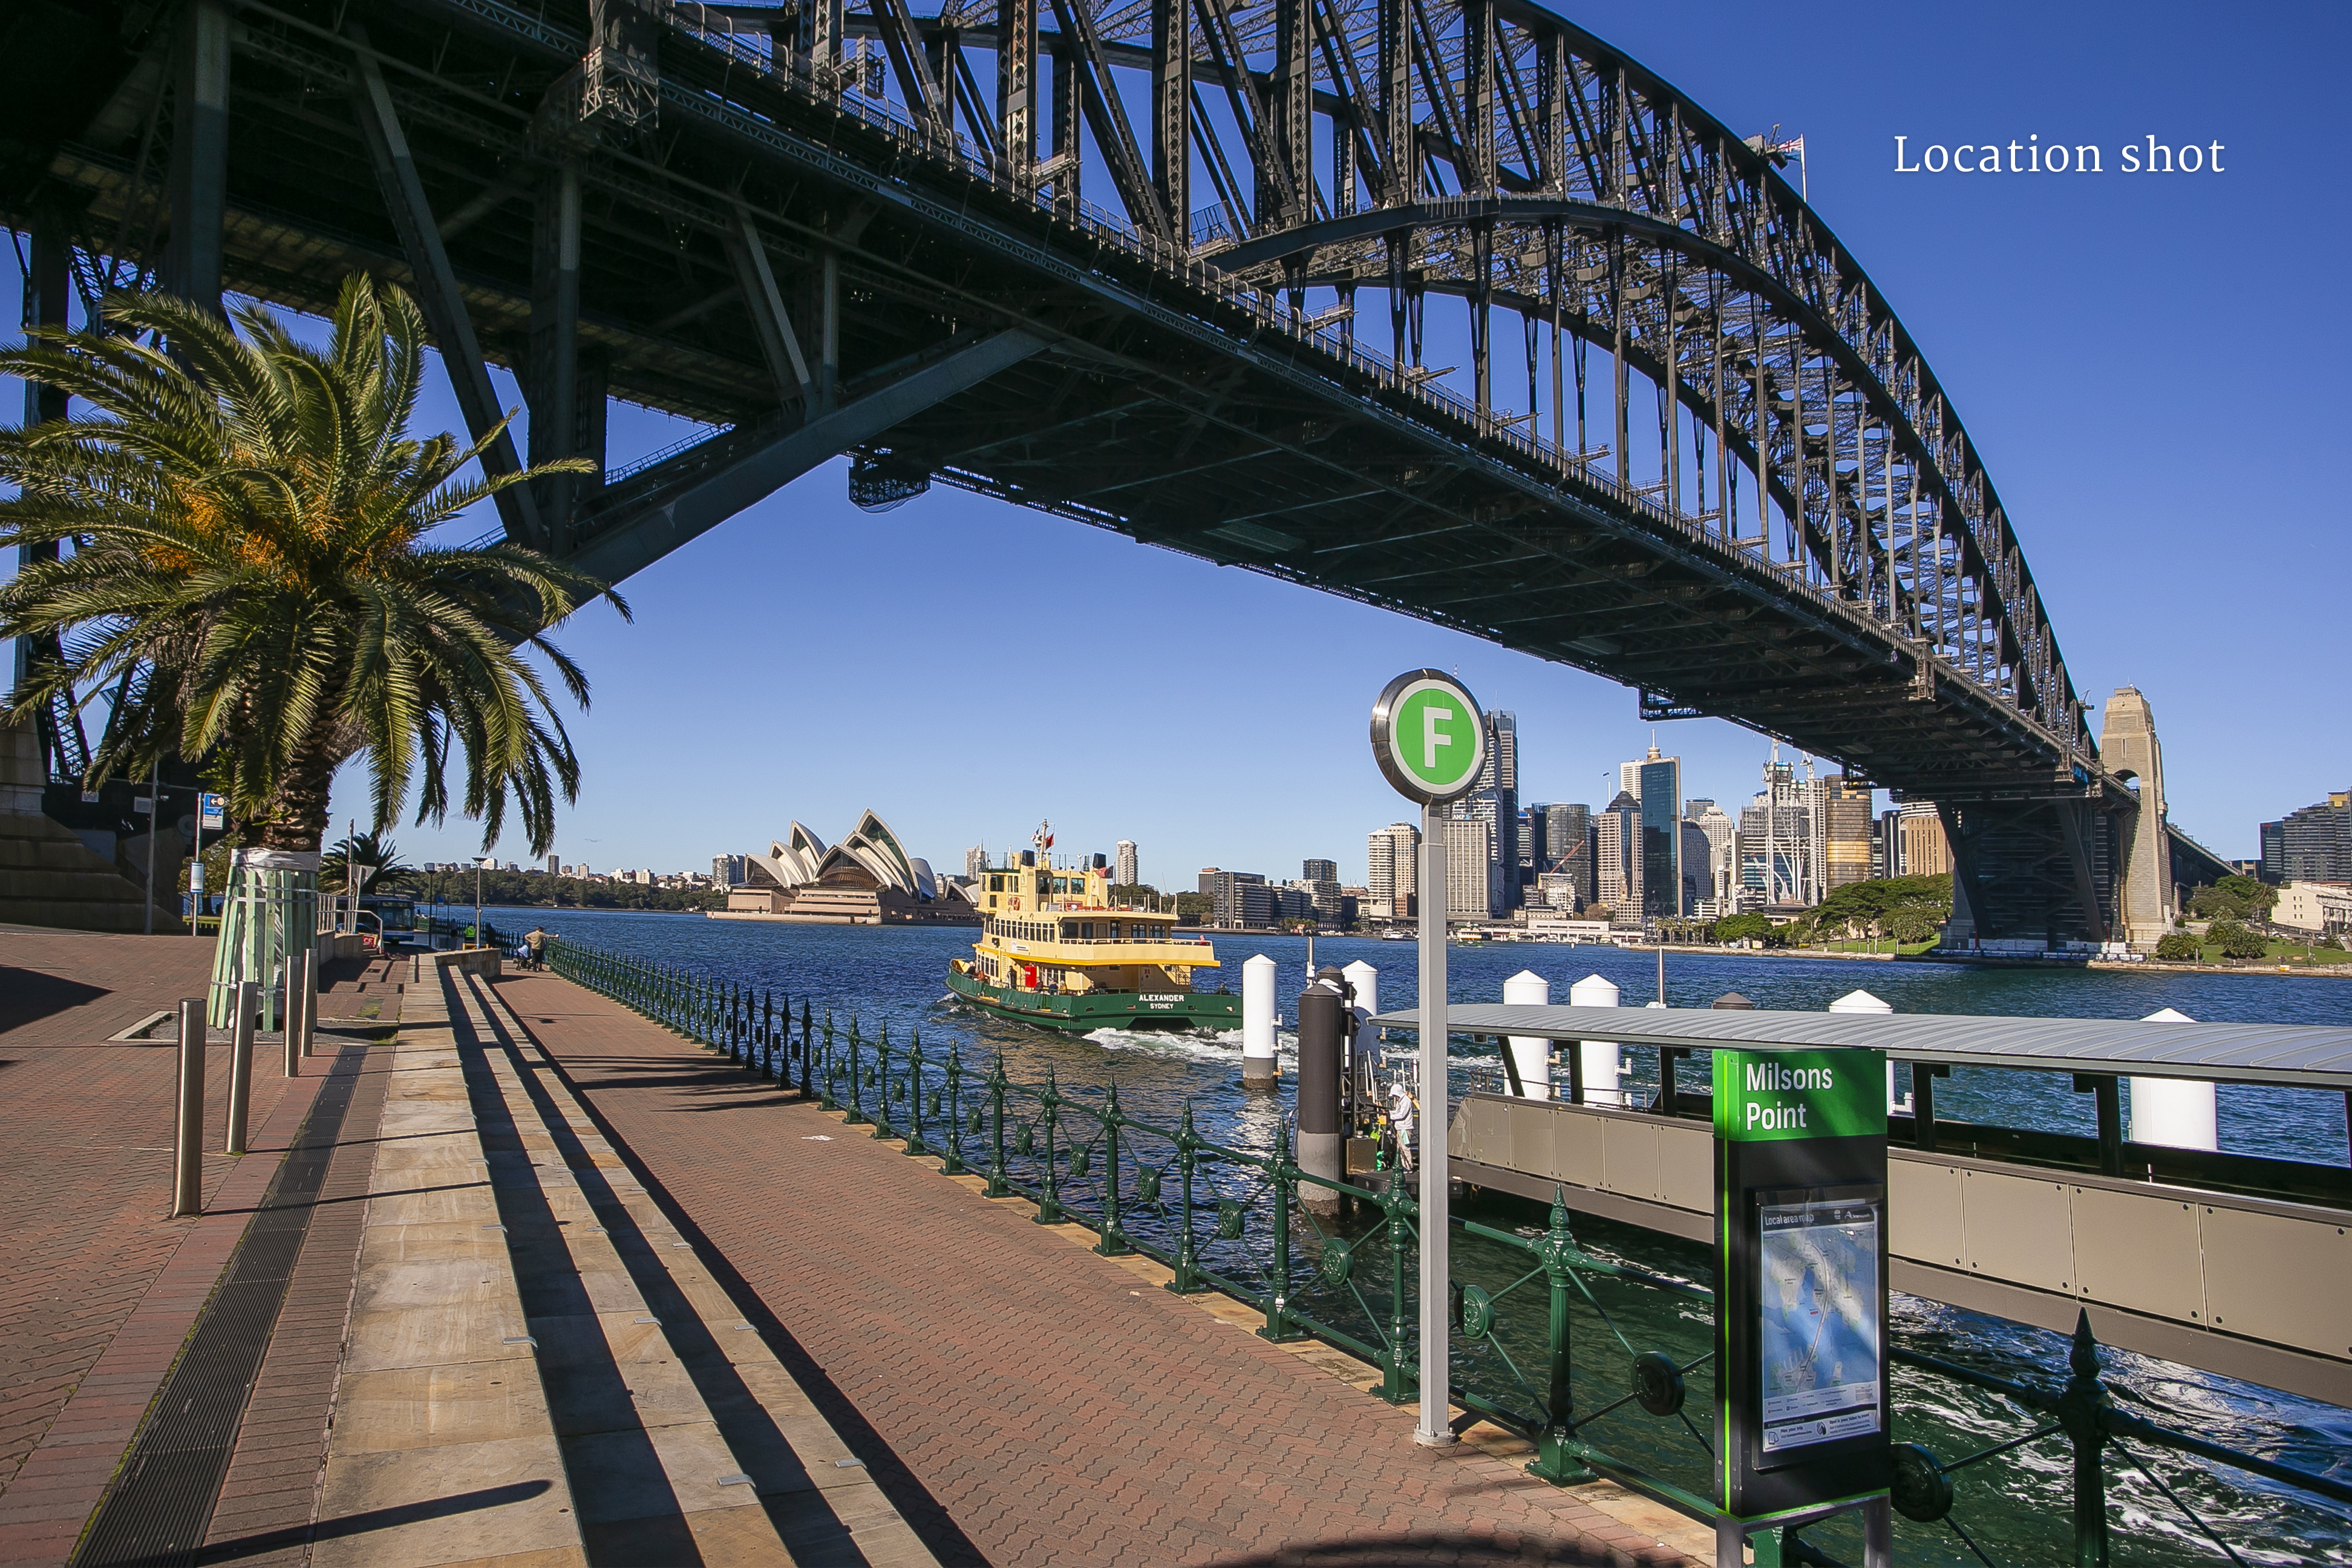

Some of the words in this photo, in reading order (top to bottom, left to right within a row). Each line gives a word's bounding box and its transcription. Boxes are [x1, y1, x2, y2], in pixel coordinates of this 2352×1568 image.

[1423, 706, 1452, 768] F
[1746, 1062, 1833, 1091] Milsons
[1746, 1101, 1806, 1131] Point
[1765, 1214, 1783, 1226] Local
[1783, 1215, 1798, 1224] area
[1798, 1214, 1814, 1224] map
